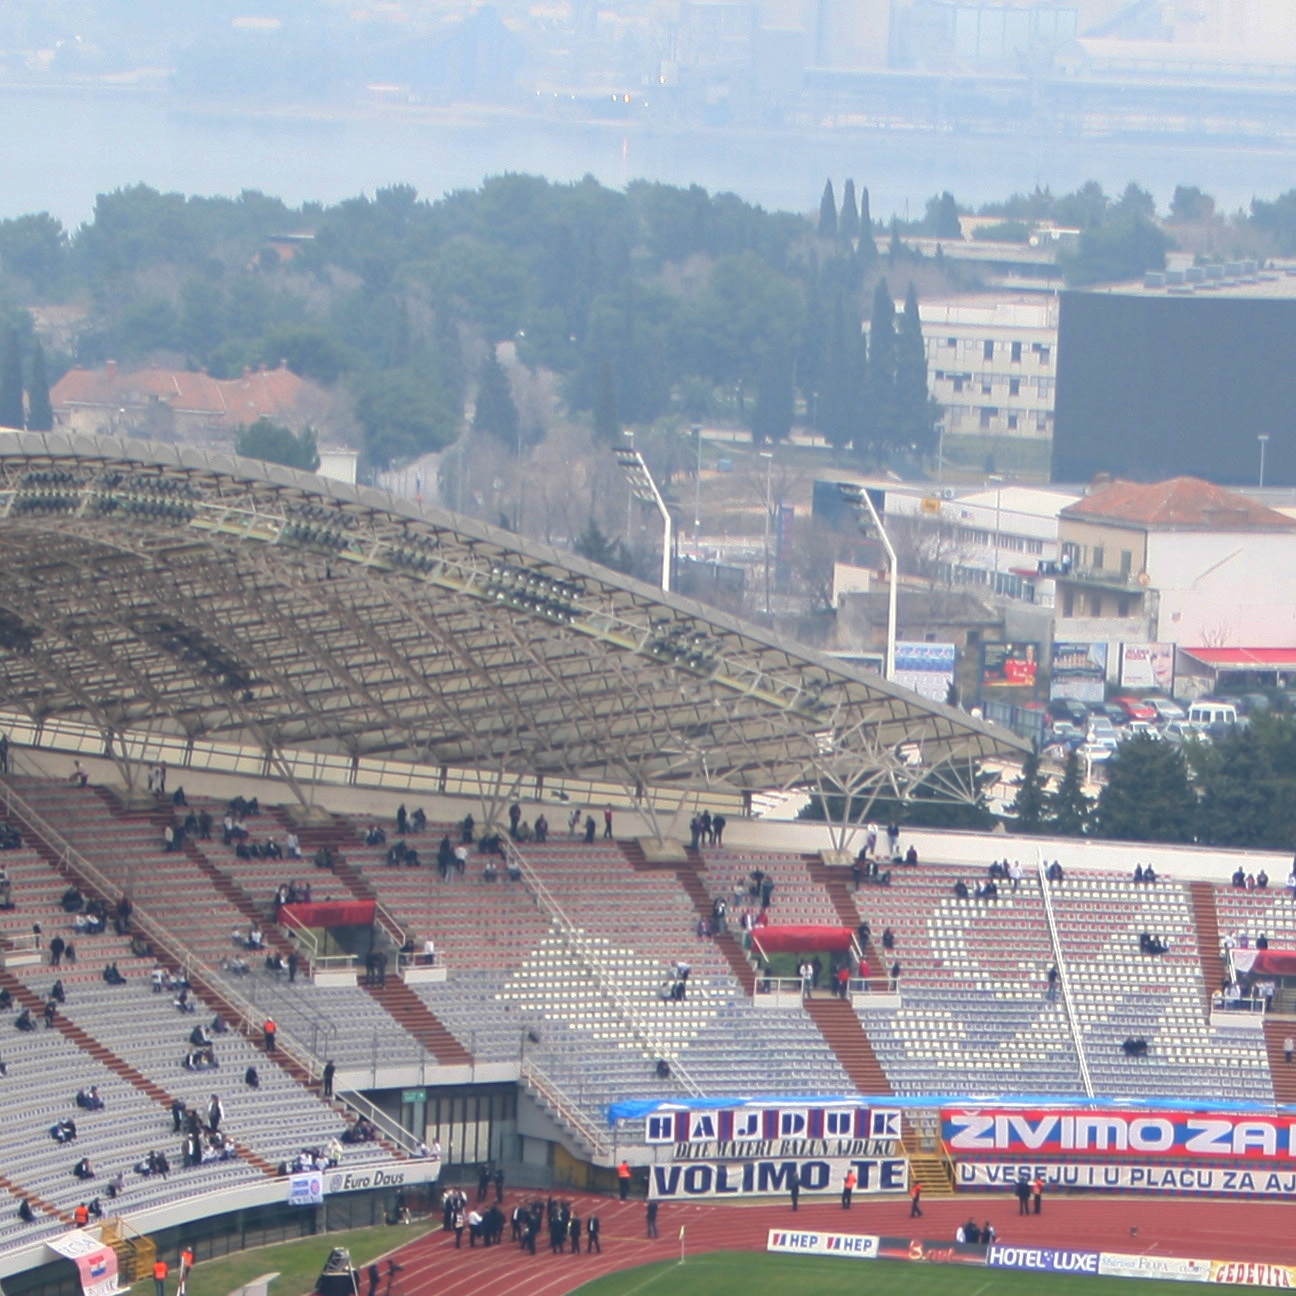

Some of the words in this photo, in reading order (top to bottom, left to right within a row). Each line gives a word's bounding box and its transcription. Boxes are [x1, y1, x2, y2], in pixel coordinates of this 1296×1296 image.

[648, 1112, 900, 1140] HAJDUK
[949, 1110, 1175, 1151] ŽIVIMO
[1185, 1119, 1277, 1156] ZA
[344, 1173, 370, 1190] Euro
[374, 1170, 404, 1186] Daus
[654, 1161, 831, 1196] VOLIMO
[851, 1159, 906, 1190] TE
[960, 1165, 977, 1183] U
[987, 1165, 1079, 1184] VESEJU
[1104, 1167, 1120, 1185] U
[1223, 1171, 1256, 1190] ZA
[789, 1233, 818, 1248] HEP
[844, 1238, 873, 1252] HEP
[990, 1247, 1045, 1267] HOTEL
[1054, 1252, 1098, 1272] LUXE
[1216, 1263, 1291, 1288] CEDEVITA
